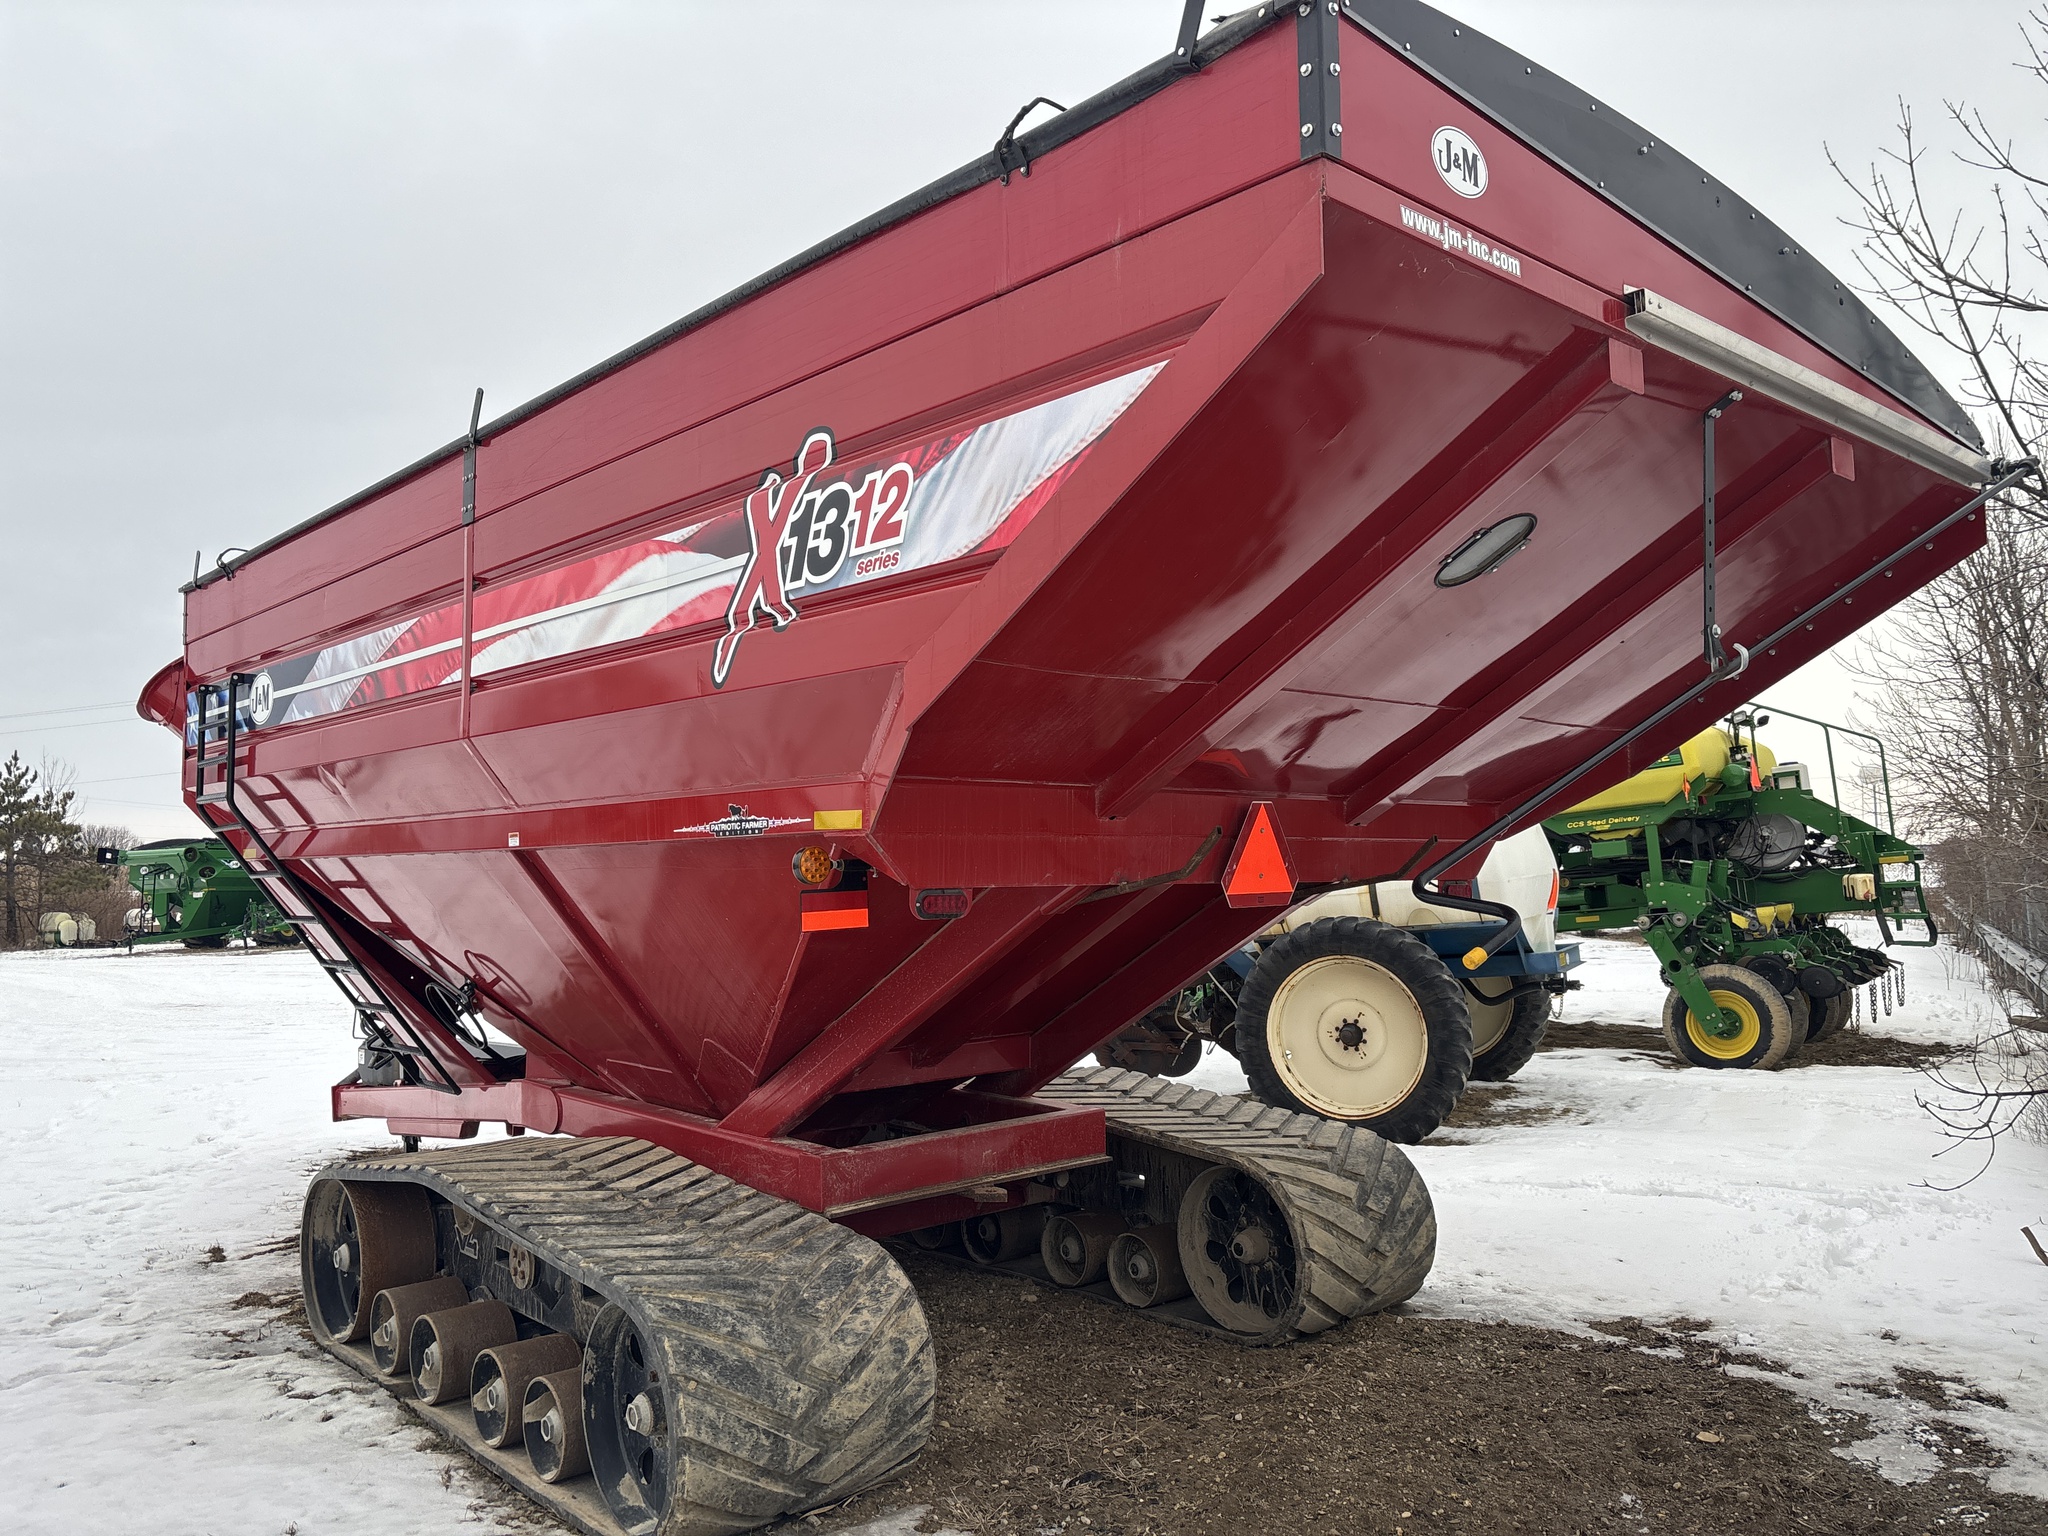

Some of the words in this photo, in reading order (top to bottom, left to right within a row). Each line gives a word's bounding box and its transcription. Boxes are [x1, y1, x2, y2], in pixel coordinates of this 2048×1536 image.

[1437, 138, 1480, 188] J&M
[1400, 205, 1521, 278] www.jm-inc.com
[856, 550, 900, 577] series
[252, 683, 270, 714] J&M
[710, 822, 741, 831] PATRIOTIC
[741, 820, 768, 829] FARMER
[1567, 821, 1585, 829] CCS
[1586, 818, 1607, 827] Seed
[1608, 815, 1641, 824] Delivery
